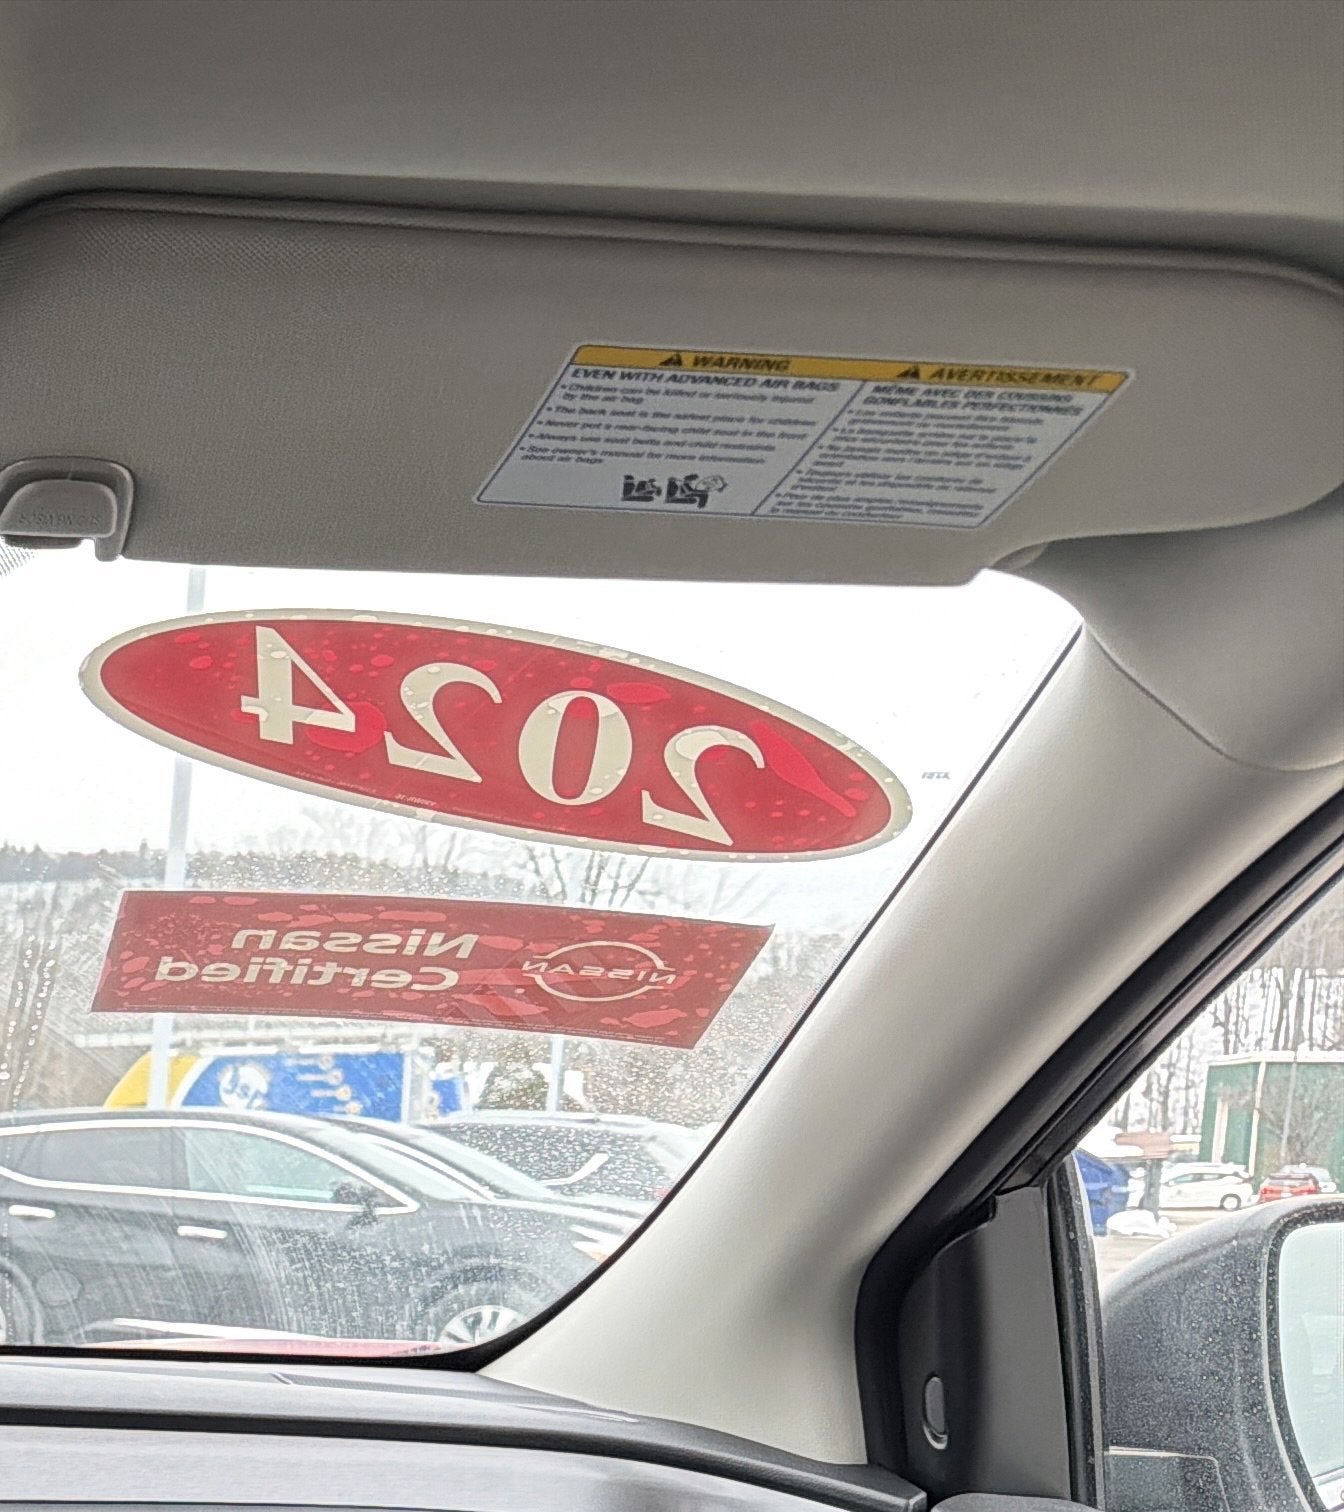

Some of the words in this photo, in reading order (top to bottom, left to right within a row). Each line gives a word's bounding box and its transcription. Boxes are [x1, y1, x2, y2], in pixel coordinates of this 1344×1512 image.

[692, 355, 790, 371] WARNING
[572, 369, 616, 380] EVEN
[619, 371, 667, 382] WITH
[668, 374, 757, 388] ADVANCED
[761, 379, 790, 389] AIR
[792, 381, 841, 393] BAGS
[928, 367, 1105, 387] AVERTISSEMENT
